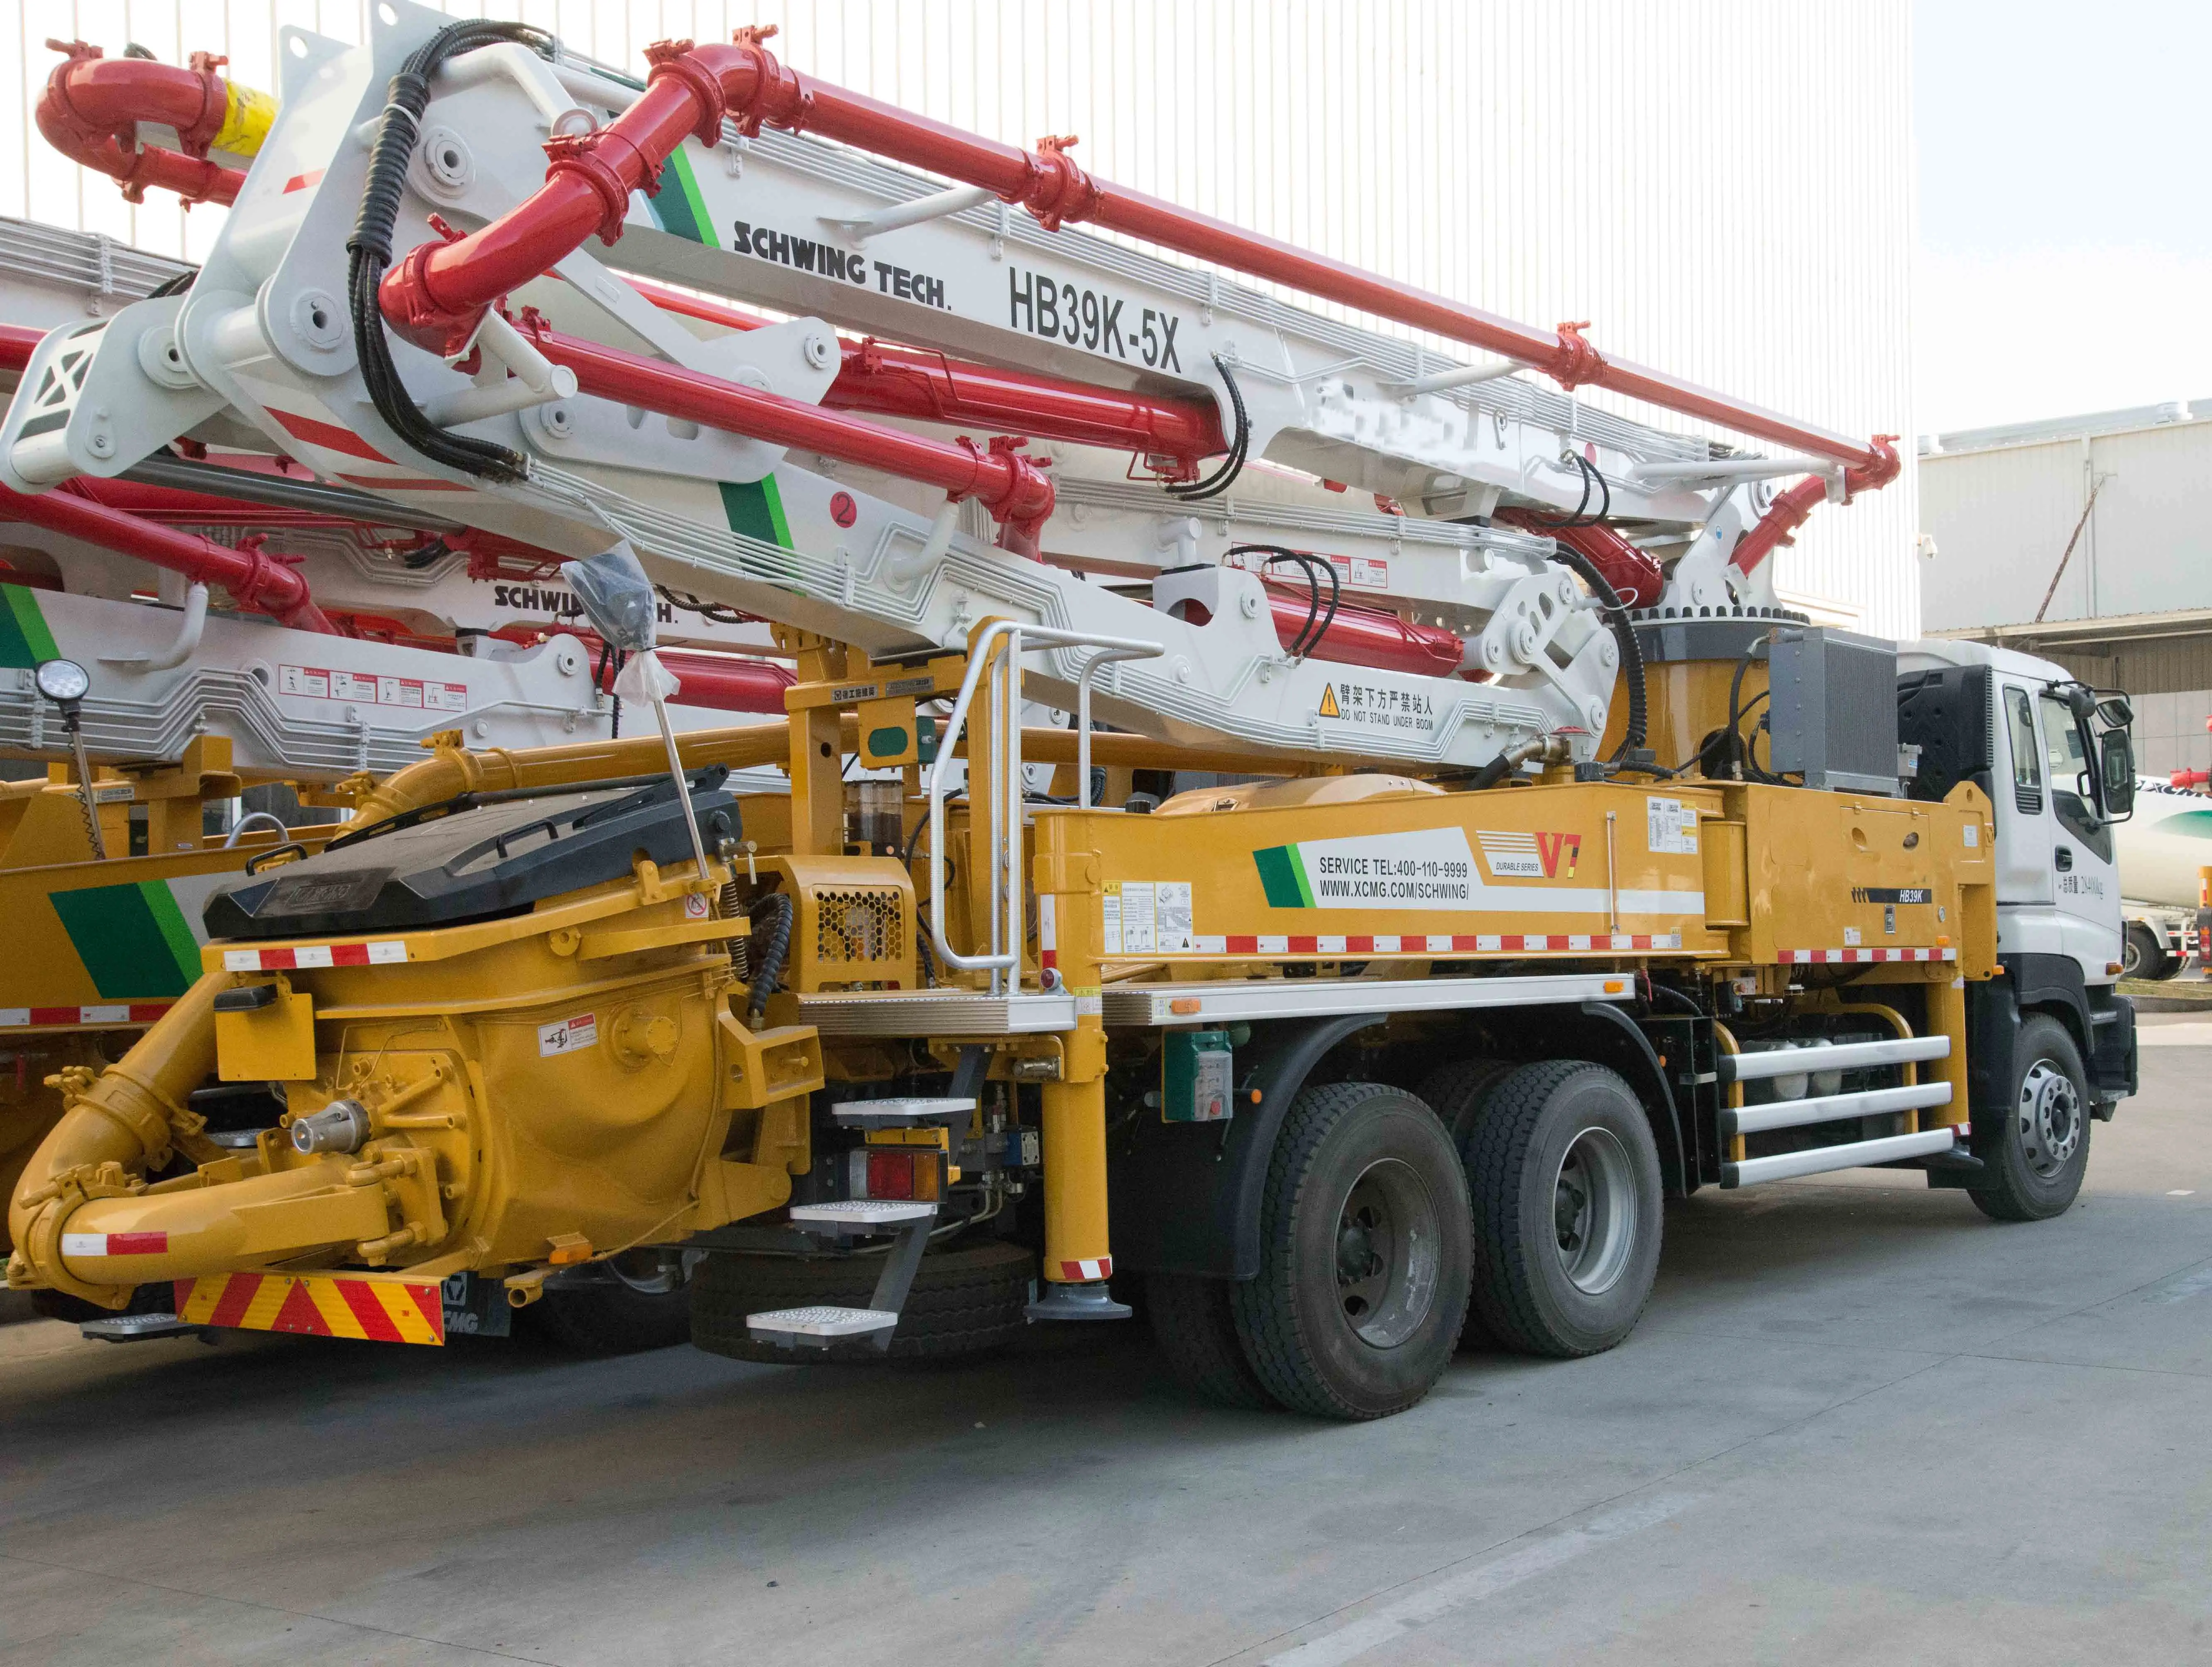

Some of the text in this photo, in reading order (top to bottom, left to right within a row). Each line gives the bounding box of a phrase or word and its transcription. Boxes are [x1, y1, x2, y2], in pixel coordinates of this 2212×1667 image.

[734, 220, 866, 285] SCHWING
[1009, 266, 1181, 374] HB39K-5X
[836, 493, 851, 524] 2
[1340, 684, 1433, 716] 臂架下方严禁站人
[1341, 709, 1433, 731] DO NOT STAND UNDER BOOM
[1320, 857, 1468, 877] SERVICE TEL:400-110-9999
[1496, 862, 1538, 871] DURABLE SERIES
[1535, 832, 1582, 879] V7
[1320, 880, 1469, 900] WWW.XCMG.COM/SCHWING/
[1899, 890, 1923, 903] HB39K
